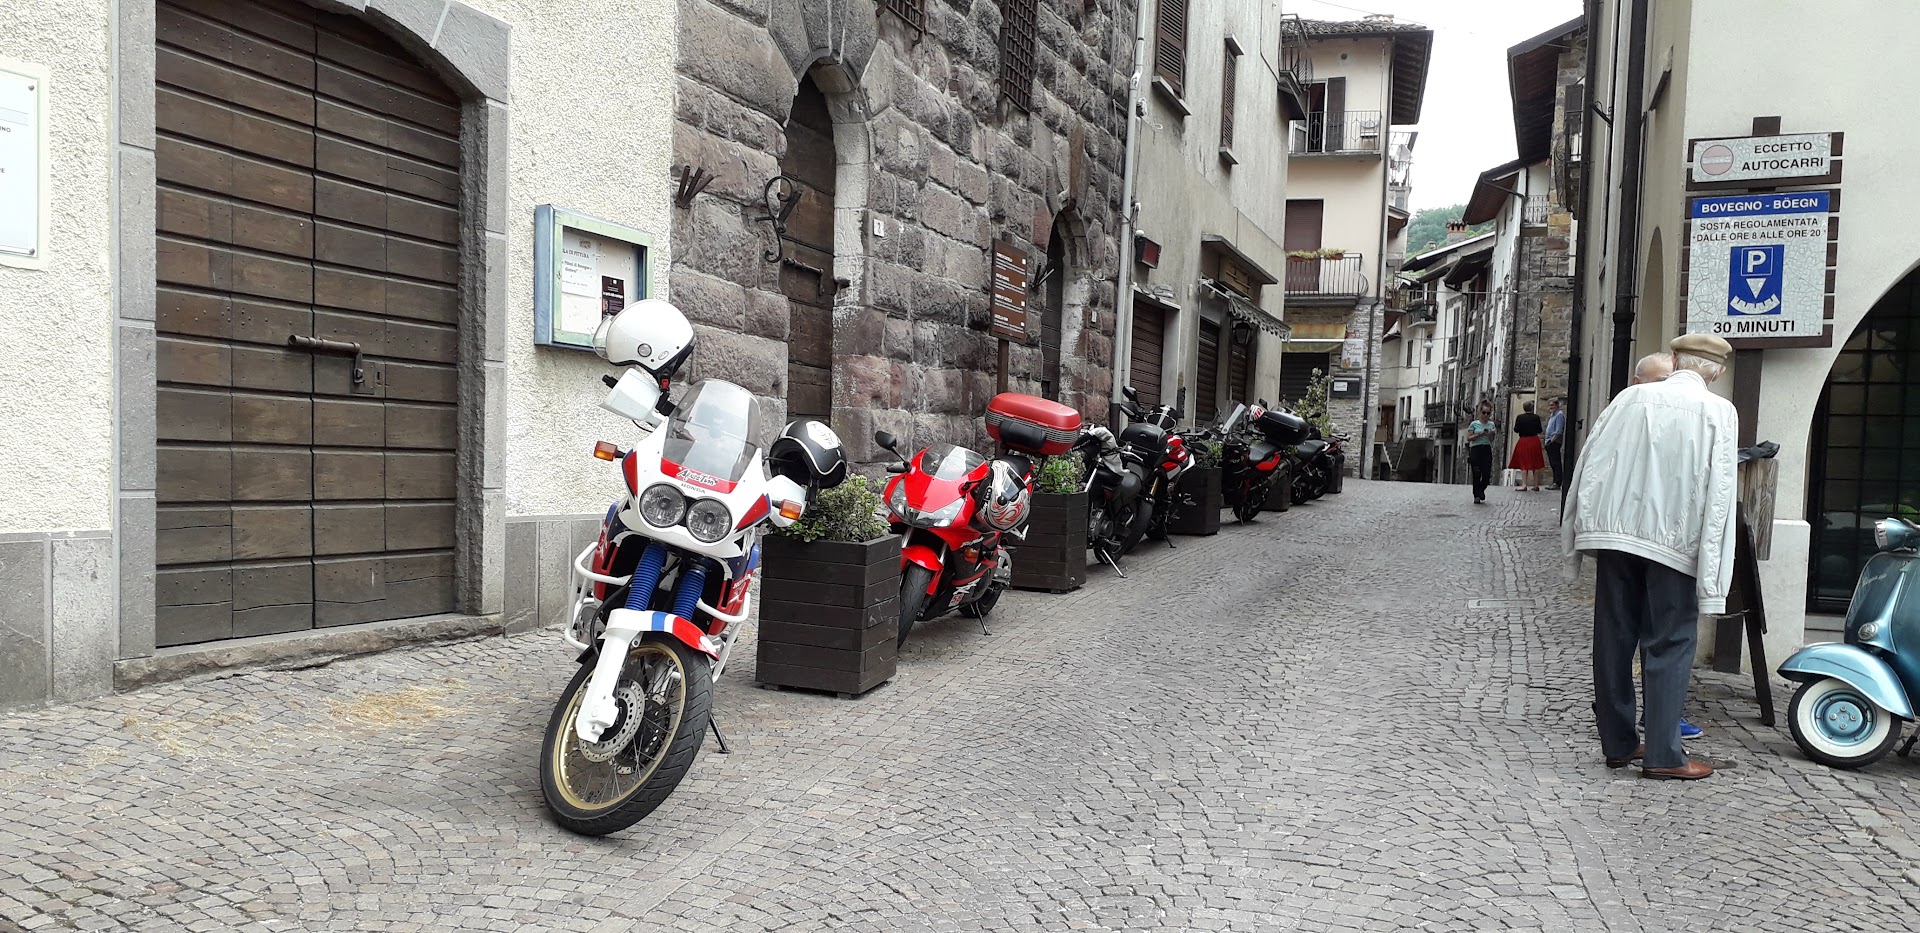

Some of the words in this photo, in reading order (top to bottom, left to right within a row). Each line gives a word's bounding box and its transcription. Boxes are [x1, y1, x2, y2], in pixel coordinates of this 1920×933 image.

[1754, 141, 1812, 154] ECCETTO
[1741, 157, 1824, 171] AUTOCARRI
[1701, 201, 1762, 213] BOVEGNO
[1773, 197, 1818, 210] BÖEGN
[1700, 222, 1731, 231] SOSTA
[1733, 218, 1818, 229] REGOLAMENTATA
[1696, 233, 1727, 242] DALLE
[1729, 232, 1749, 240] ORE
[1752, 231, 1757, 240] 8
[1760, 230, 1784, 239] ALLE
[1787, 229, 1807, 238] ORE
[1810, 229, 1821, 237] 20
[1747, 250, 1766, 273] P
[1713, 321, 1732, 334] 30
[1737, 320, 1795, 333] MINUTI
[681, 482, 706, 494] HONDA
